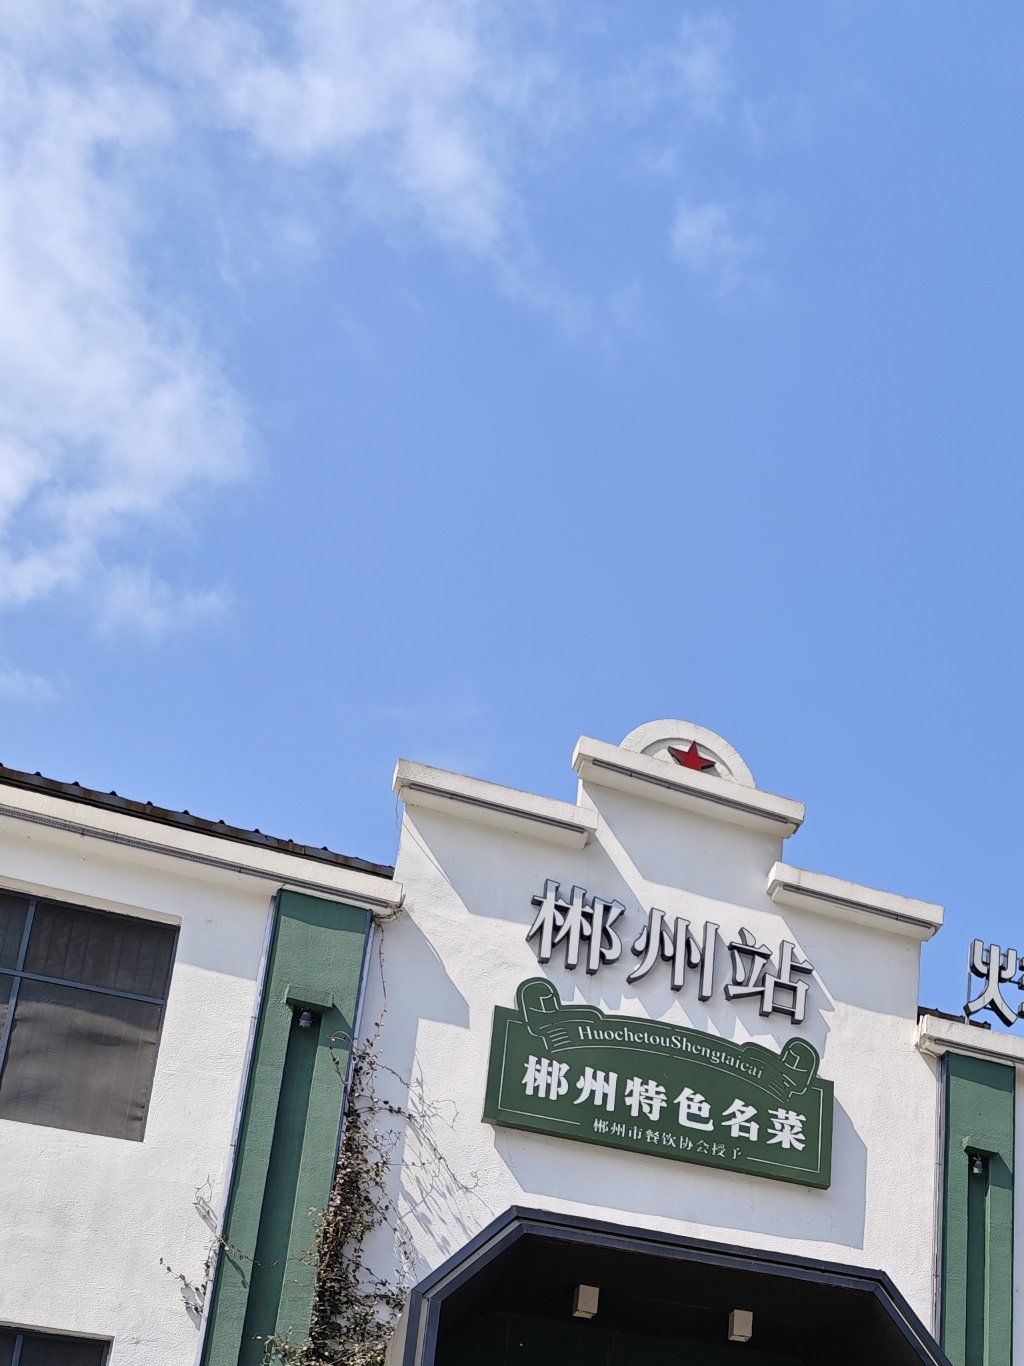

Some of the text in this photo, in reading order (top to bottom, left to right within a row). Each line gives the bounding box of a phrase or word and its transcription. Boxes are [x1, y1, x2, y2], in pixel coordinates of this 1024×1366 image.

[525, 879, 815, 1024] 郴州站
[577, 1025, 764, 1079] HuochetouShengtaicai
[521, 1054, 807, 1151] 郴州特色名菜
[592, 1117, 743, 1160] 郴州市餐饮协会授予
